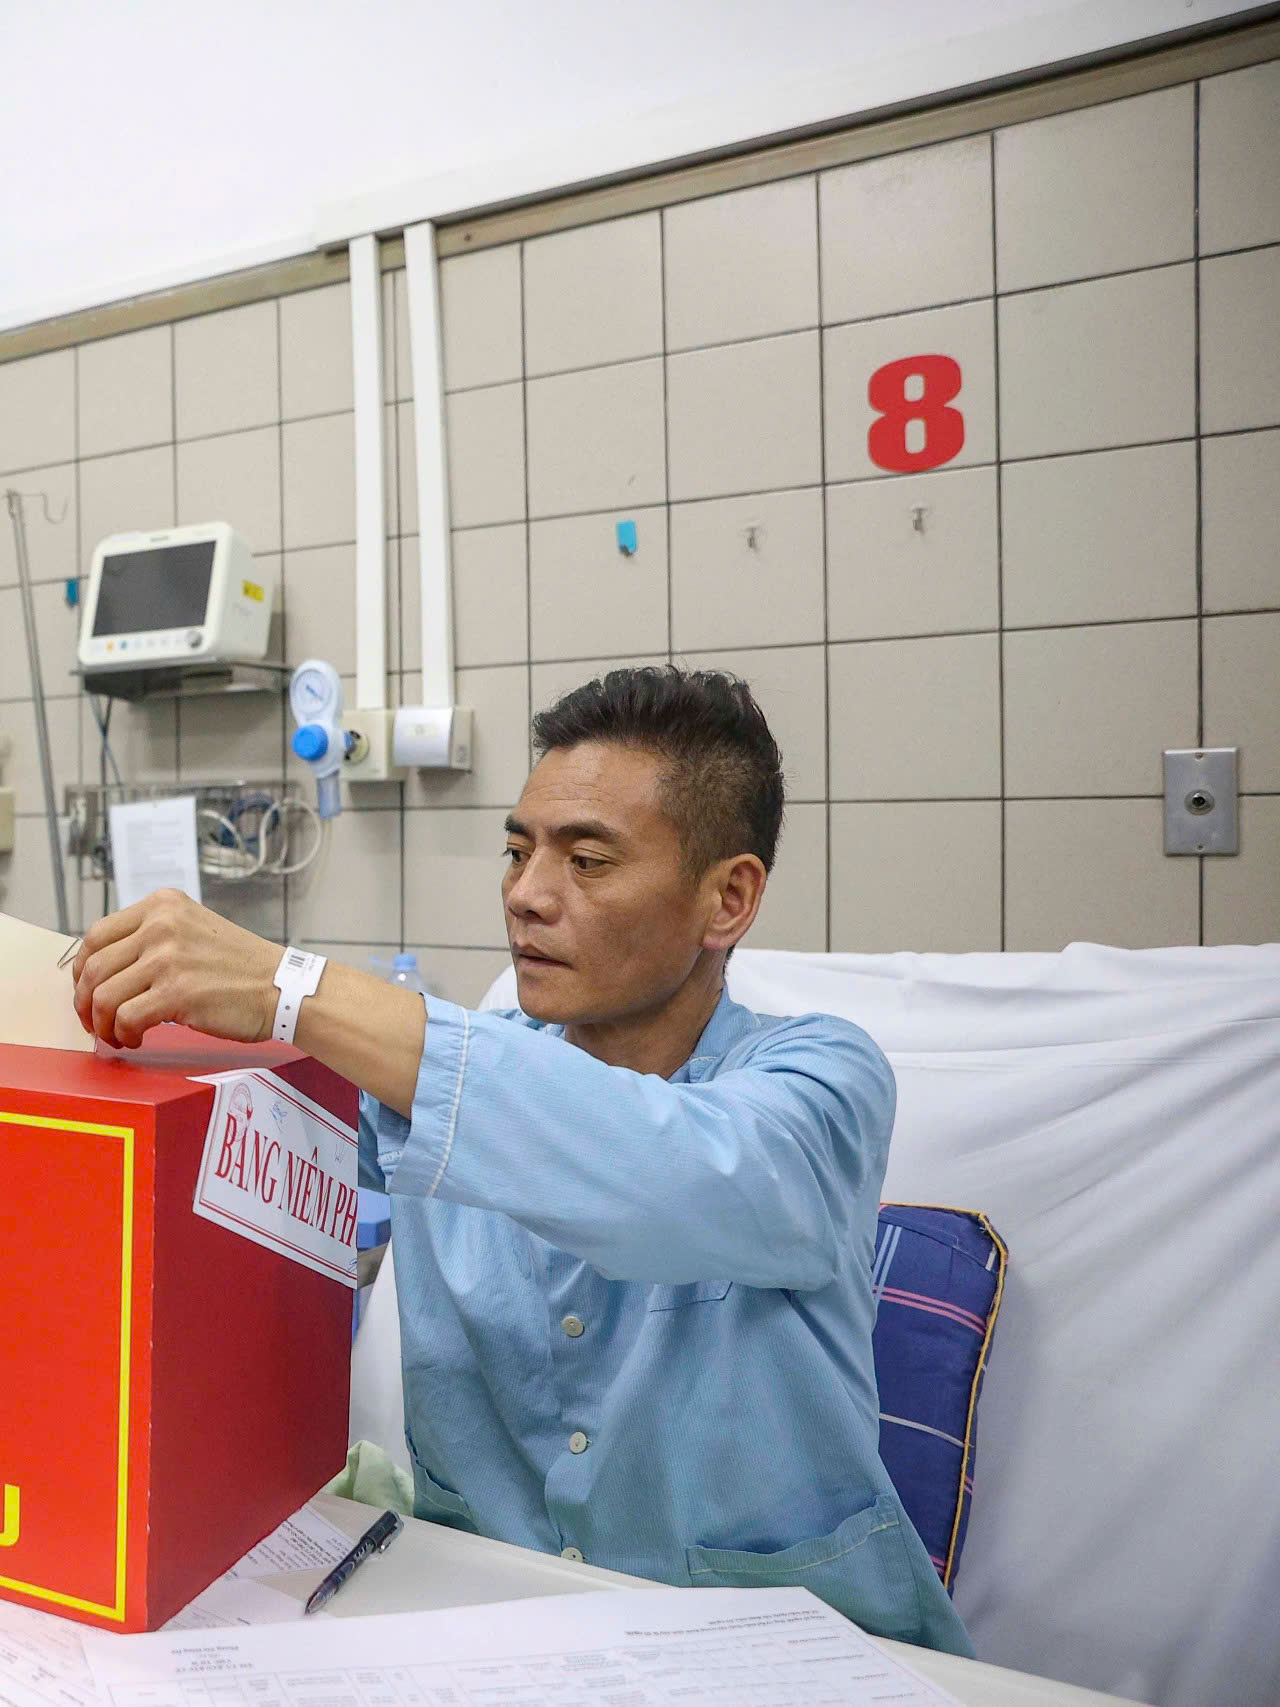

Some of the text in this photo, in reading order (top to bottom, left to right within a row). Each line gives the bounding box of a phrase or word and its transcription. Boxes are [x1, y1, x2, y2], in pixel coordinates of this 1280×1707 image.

[868, 353, 965, 474] 8
[214, 1107, 281, 1204] BẢNG
[278, 1146, 334, 1233] NIÊM
